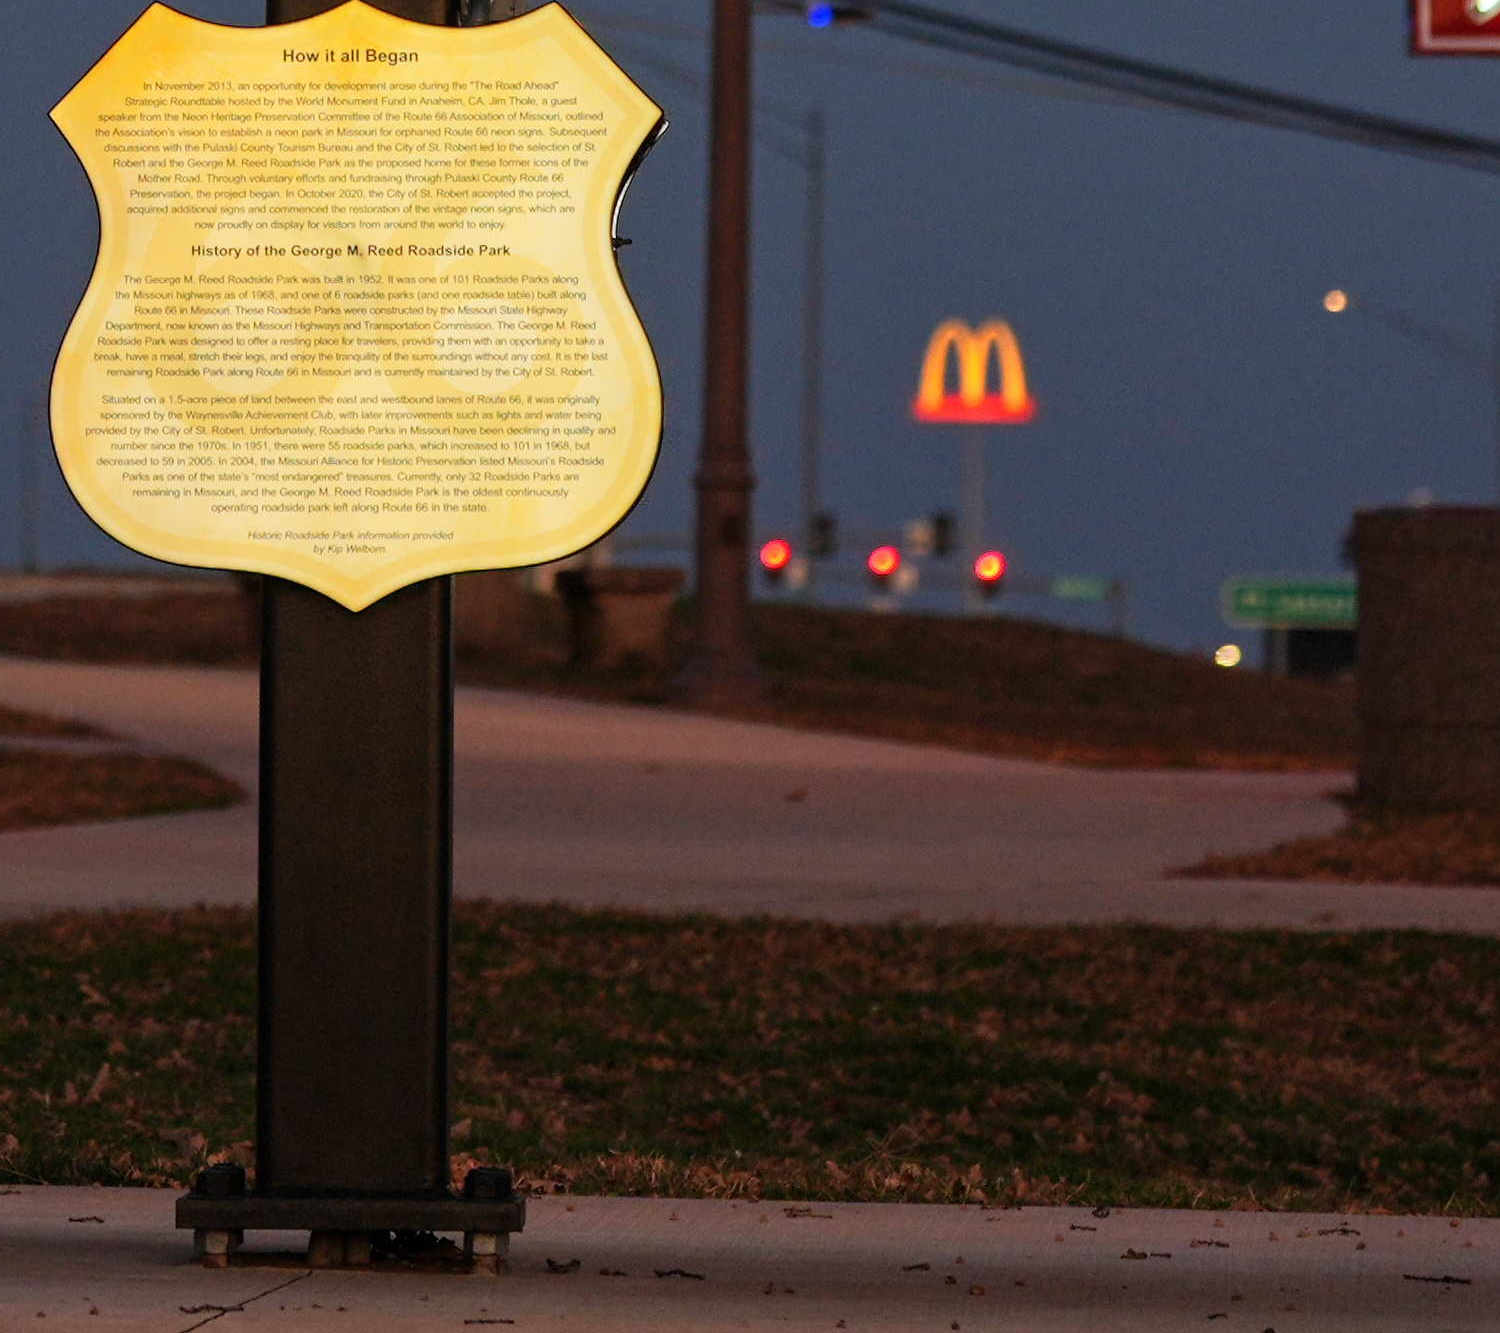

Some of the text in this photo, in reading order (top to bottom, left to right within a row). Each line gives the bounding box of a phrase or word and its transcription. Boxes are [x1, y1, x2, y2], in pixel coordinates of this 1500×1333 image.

[283, 49, 418, 66] How it all Began
[155, 81, 205, 91] November
[252, 81, 307, 93] opportunity
[309, 81, 322, 91] for
[324, 81, 387, 93] development
[389, 83, 417, 91] arose
[419, 81, 450, 93] during
[452, 81, 467, 91] the
[495, 81, 522, 91] Road
[98, 112, 137, 124] speaker
[140, 112, 162, 122] from
[164, 112, 180, 122] the
[182, 112, 209, 122] Neon
[211, 112, 252, 124] Heritage
[255, 112, 316, 122] Preservation
[318, 112, 371, 122] Committee
[385, 112, 401, 122] the
[403, 112, 433, 122] Route
[450, 112, 505, 122] Association
[565, 112, 604, 122] outlined
[137, 173, 172, 183] Mother
[206, 173, 247, 185] Through
[249, 173, 293, 185] voluntary
[296, 173, 326, 183] efforts
[328, 173, 347, 183] and
[349, 173, 403, 185] fundraising
[405, 173, 442, 185] through
[445, 173, 480, 183] Pulaski
[482, 173, 517, 185] County
[520, 173, 549, 183] Route
[196, 189, 212, 199] the
[214, 189, 247, 201] project
[297, 189, 336, 199] October
[369, 189, 384, 199] the
[387, 189, 406, 201] City
[436, 189, 469, 199] Robert
[471, 189, 516, 201] accepted
[518, 189, 534, 199] the
[191, 245, 510, 260] History of the George M. Reed Roadside Park
[123, 274, 142, 284] The
[145, 274, 181, 286] George
[199, 274, 225, 284] Reed
[228, 274, 274, 284] Roadside
[276, 274, 299, 284] Park
[301, 276, 321, 284] was
[323, 274, 344, 284] built
[396, 276, 416, 284] was
[419, 276, 437, 284] one
[473, 274, 519, 284] Roadside
[521, 274, 550, 284] Parks
[552, 274, 579, 286] along
[110, 441, 148, 451] number
[150, 441, 176, 451] since
[179, 441, 194, 451] the
[274, 441, 299, 451] there
[301, 443, 326, 451] were
[343, 441, 385, 451] roadside
[420, 441, 448, 451] which
[451, 441, 498, 451] increased
[575, 441, 590, 451] but
[247, 530, 454, 542] Historic Roadside Park information provided
